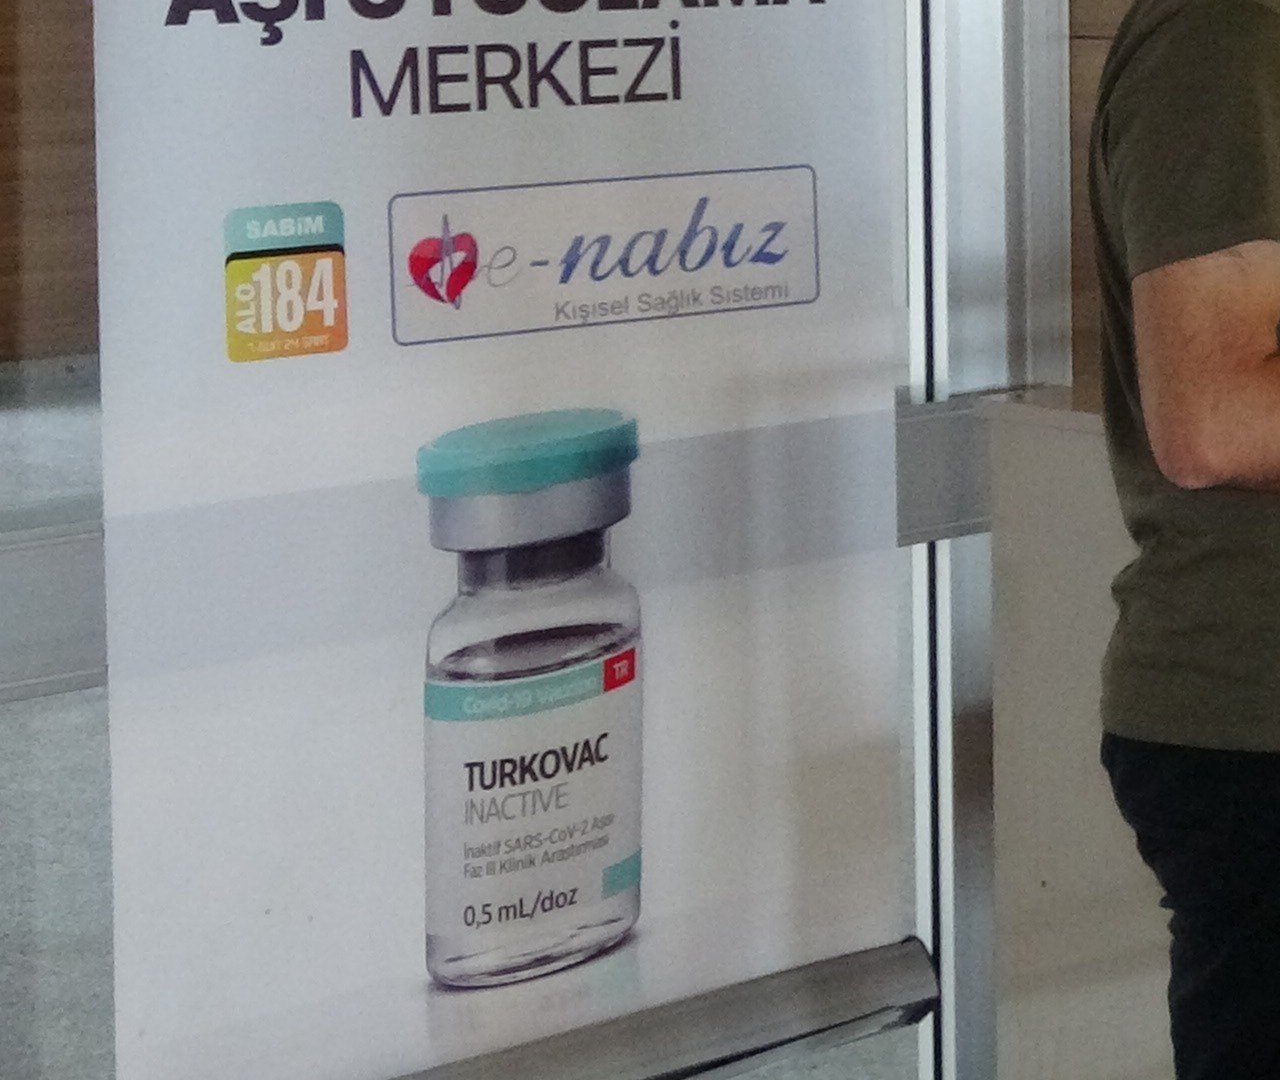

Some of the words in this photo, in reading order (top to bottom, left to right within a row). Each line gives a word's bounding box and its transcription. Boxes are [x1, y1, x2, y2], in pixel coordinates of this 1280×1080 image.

[350, 21, 682, 118] MERKEZİ
[235, 283, 257, 334] ALO
[252, 258, 338, 333] 184
[638, 289, 704, 314] Sağlık
[464, 732, 609, 792] TURKOVAC
[465, 782, 569, 825] INACTIVE
[504, 819, 589, 854] SARS-CoV-2
[464, 863, 483, 878] Faz
[500, 854, 536, 874] Klinik
[463, 903, 492, 929] 0,5
[498, 887, 579, 922] mL/doz
